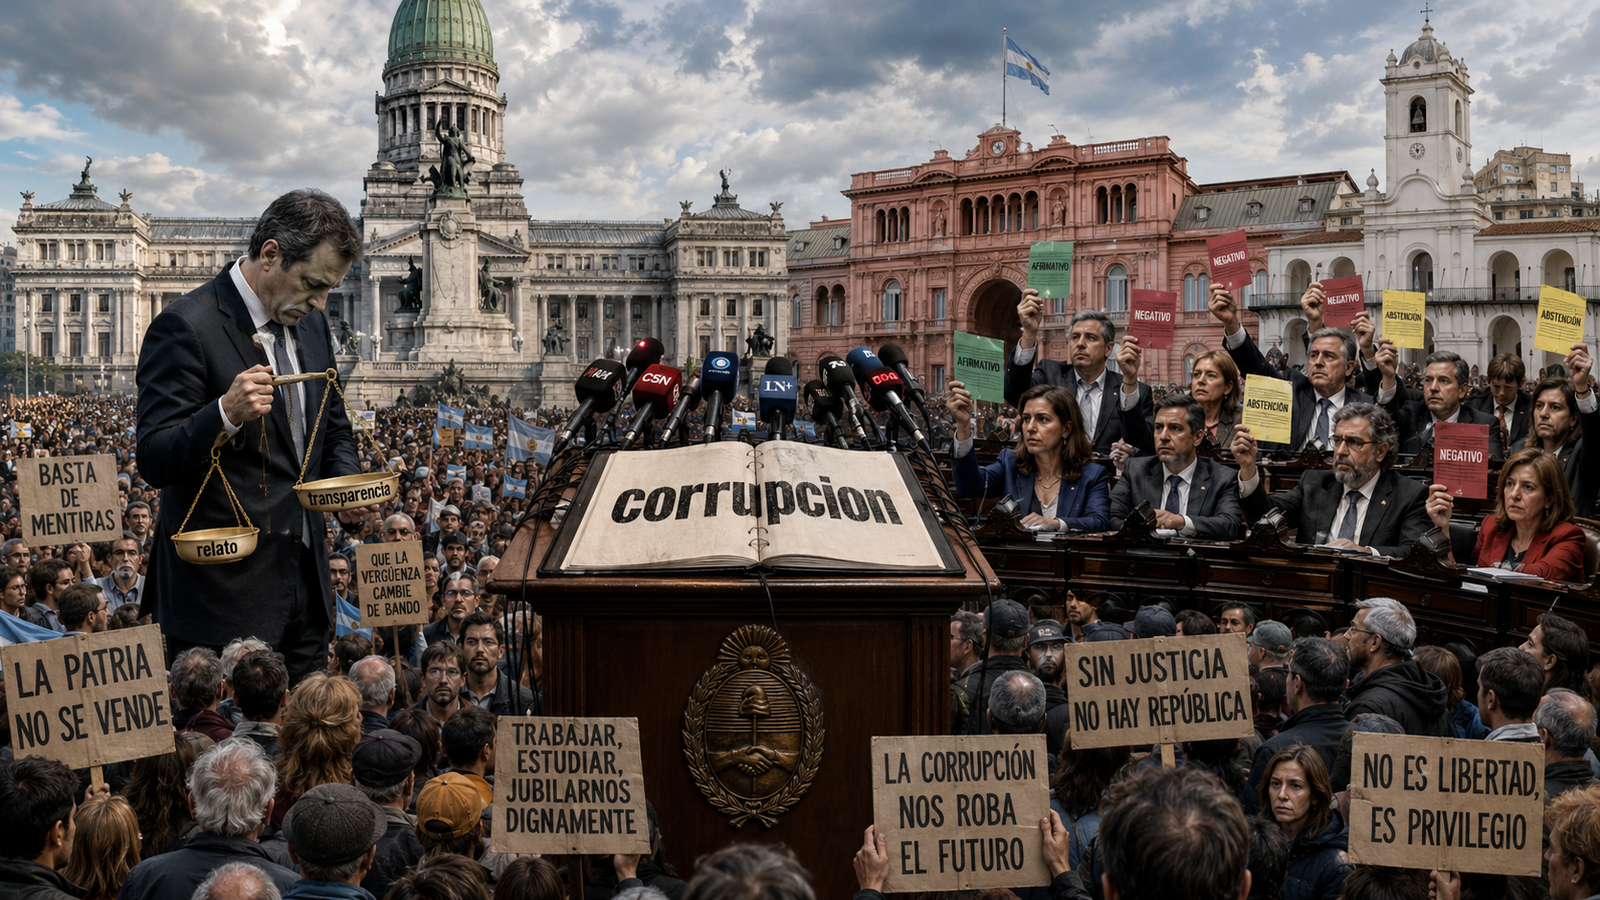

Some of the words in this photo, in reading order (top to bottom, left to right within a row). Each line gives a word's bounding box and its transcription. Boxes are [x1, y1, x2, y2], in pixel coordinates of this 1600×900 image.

[1213, 250, 1246, 267] NEGATIVO
[1134, 309, 1171, 323] NEGATIVO
[956, 355, 1001, 374] AFIRMATIVO
[642, 372, 672, 386] C5N
[1439, 448, 1483, 464] NEGATIVO
[38, 461, 97, 487] BASTA
[60, 488, 81, 509] DE
[307, 481, 392, 508] transparencia
[610, 475, 904, 526] corrupcion
[31, 509, 116, 537] MENTIRAS
[196, 540, 238, 559] relato
[371, 552, 392, 567] QUE
[395, 551, 409, 565] LA
[361, 566, 422, 585] VERGÜENZA
[372, 584, 413, 600] CAMBIE
[367, 603, 381, 618] DE
[384, 600, 421, 617] BANDO
[14, 659, 53, 699] LA
[63, 643, 153, 691] PATRIA
[1077, 654, 1116, 689] SIN
[1125, 647, 1229, 685] JUSTICIA
[14, 710, 50, 750] NO
[60, 704, 89, 742] SE
[94, 690, 168, 737] VENDE
[1074, 699, 1100, 733] NO
[1107, 697, 1141, 730] HAY
[1148, 687, 1248, 727] REPÚBLICA
[511, 723, 623, 750] TRABAJAR,
[517, 750, 623, 777] ESTUDIAR,
[884, 752, 911, 784] LA
[921, 743, 1036, 784] CORRUPCIÓN
[1363, 753, 1393, 789] NO
[1403, 755, 1428, 791] ES
[1438, 756, 1540, 801] LIBERTAD,
[506, 778, 631, 804] JUBILARNOS
[506, 807, 637, 835] DIGNAMENTE
[899, 794, 945, 829] NOS
[957, 792, 1018, 827] ROBA
[1370, 806, 1396, 844] ES
[1408, 808, 1527, 850] PRIVILEGIO
[900, 840, 927, 875] EL
[939, 836, 1024, 873] FUTURO
